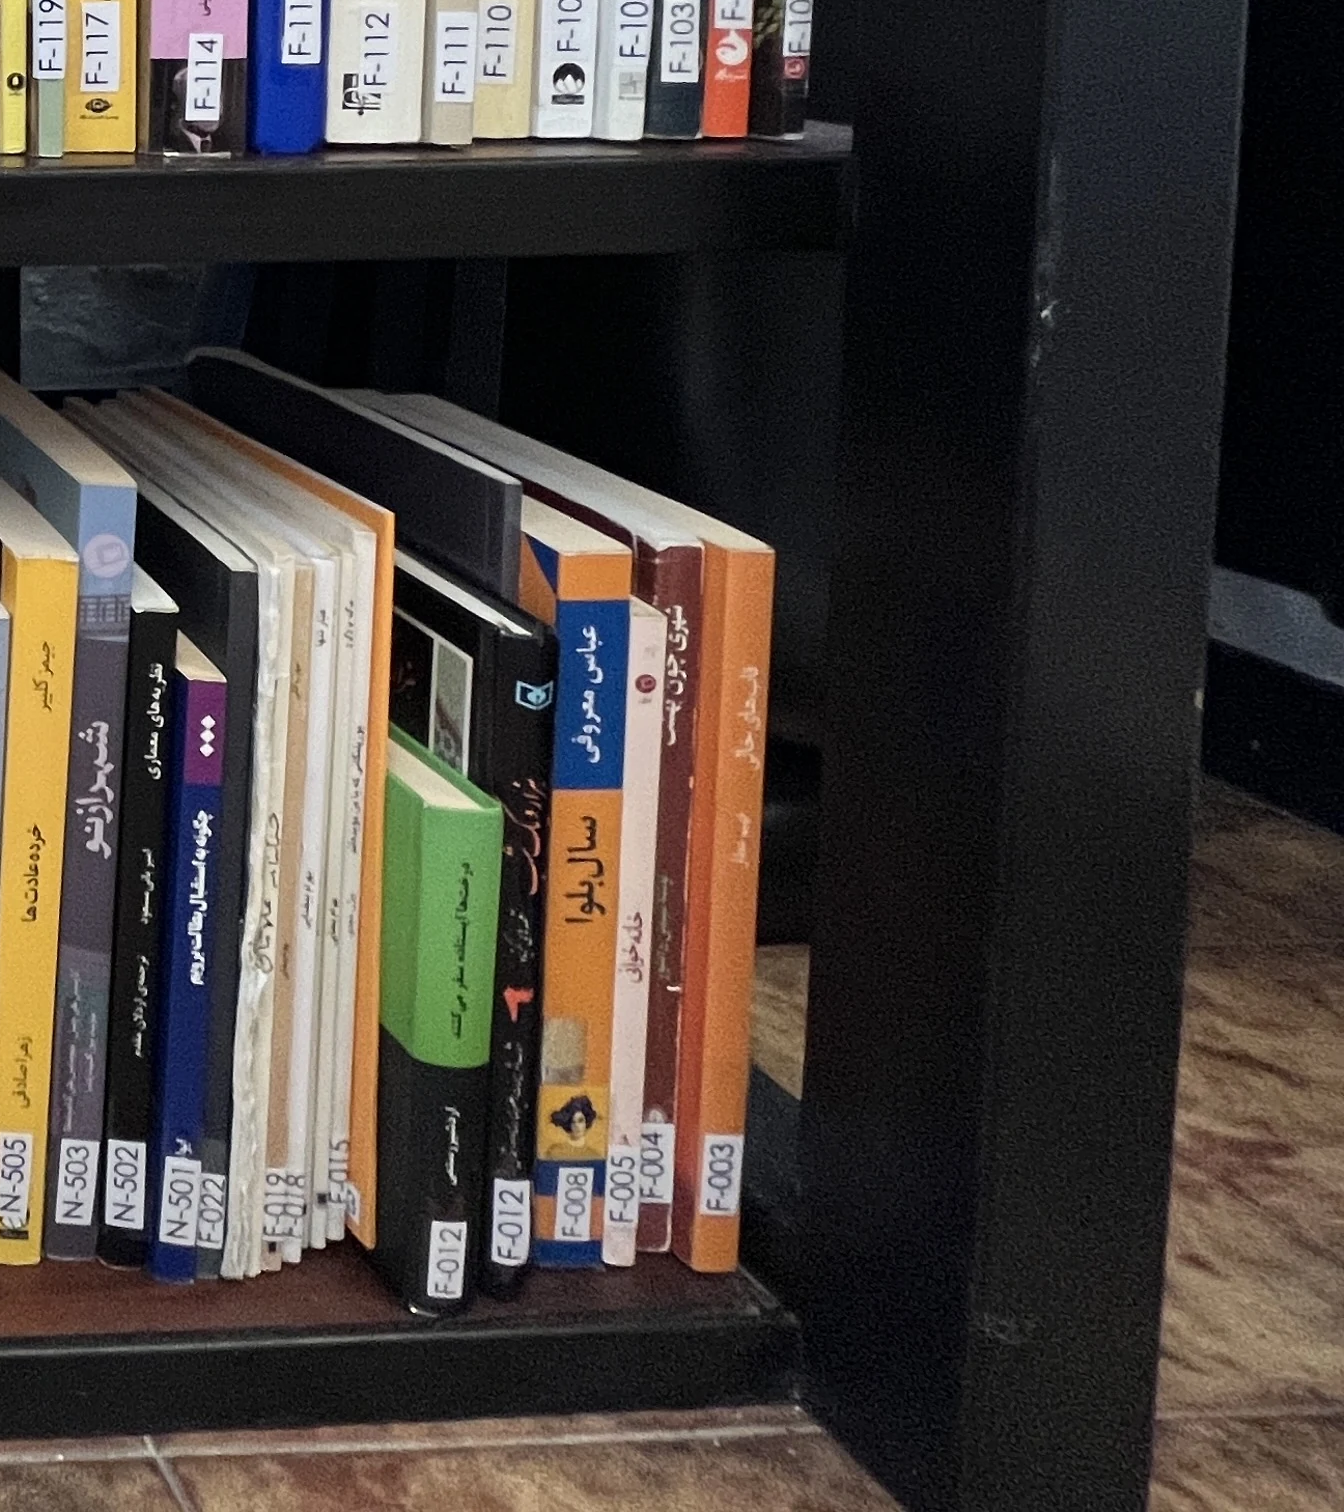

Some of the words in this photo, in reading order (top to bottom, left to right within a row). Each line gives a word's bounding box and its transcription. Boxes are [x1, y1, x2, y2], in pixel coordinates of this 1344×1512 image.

[86, 13, 108, 84] F-117
[364, 13, 390, 86] F-112
[443, 25, 468, 95] F-111
[484, 4, 511, 78] F-110
[669, 2, 696, 74] F-103
[195, 39, 217, 111] F-114
[574, 626, 604, 684] عباس
[570, 690, 601, 763] معروفی
[567, 816, 605, 877] سال
[563, 879, 604, 924] بلوا
[1, 1140, 26, 1213] N-505
[63, 1146, 89, 1220] N-503
[114, 1147, 138, 1222] N-502
[610, 1156, 633, 1223] F-005
[640, 1132, 663, 1199] F-004
[708, 1143, 734, 1211] F-003
[170, 1167, 194, 1239] N-501
[202, 1179, 225, 1244] F-022
[499, 1192, 524, 1260] F-012
[564, 1173, 587, 1237] F-008
[433, 1227, 460, 1295] F-012
